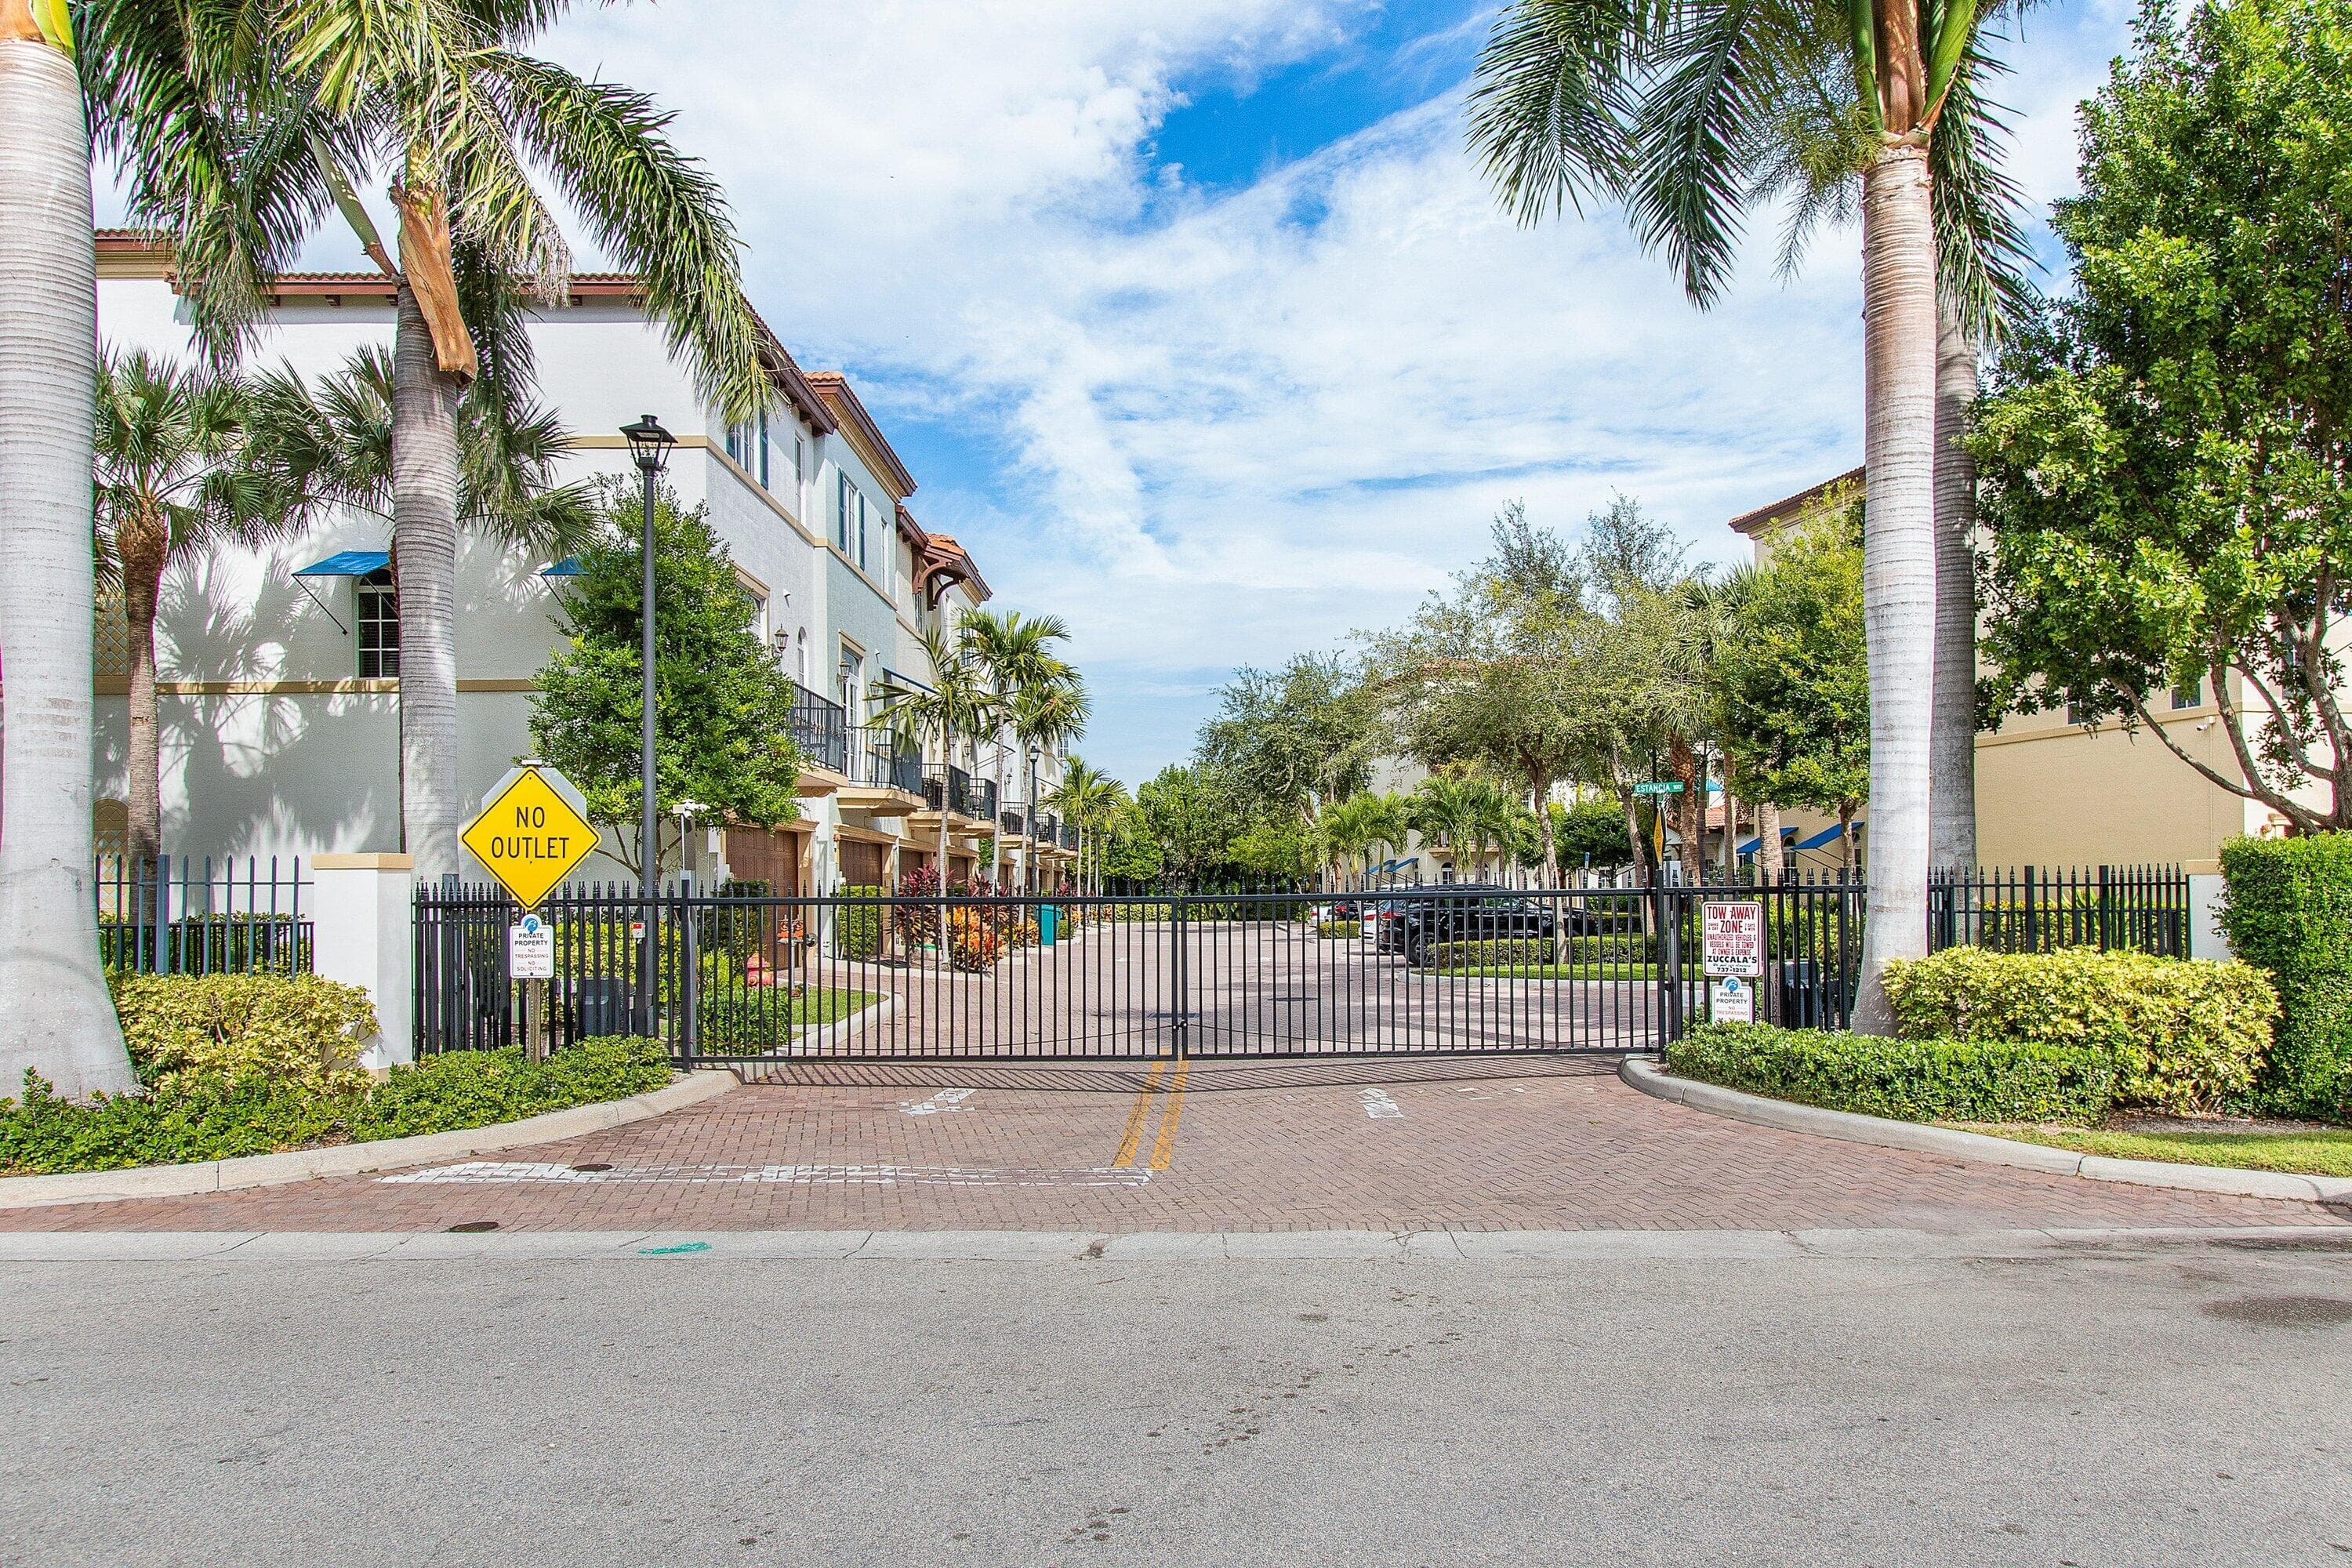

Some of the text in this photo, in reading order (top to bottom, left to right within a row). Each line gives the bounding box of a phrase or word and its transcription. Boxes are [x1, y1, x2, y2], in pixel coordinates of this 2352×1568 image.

[1636, 784, 1671, 793] ESTANCIA
[516, 807, 545, 829] NO
[492, 837, 569, 858] OUTLET
[1708, 906, 1756, 920] TOW AWAY
[1720, 920, 1743, 933] ZONE
